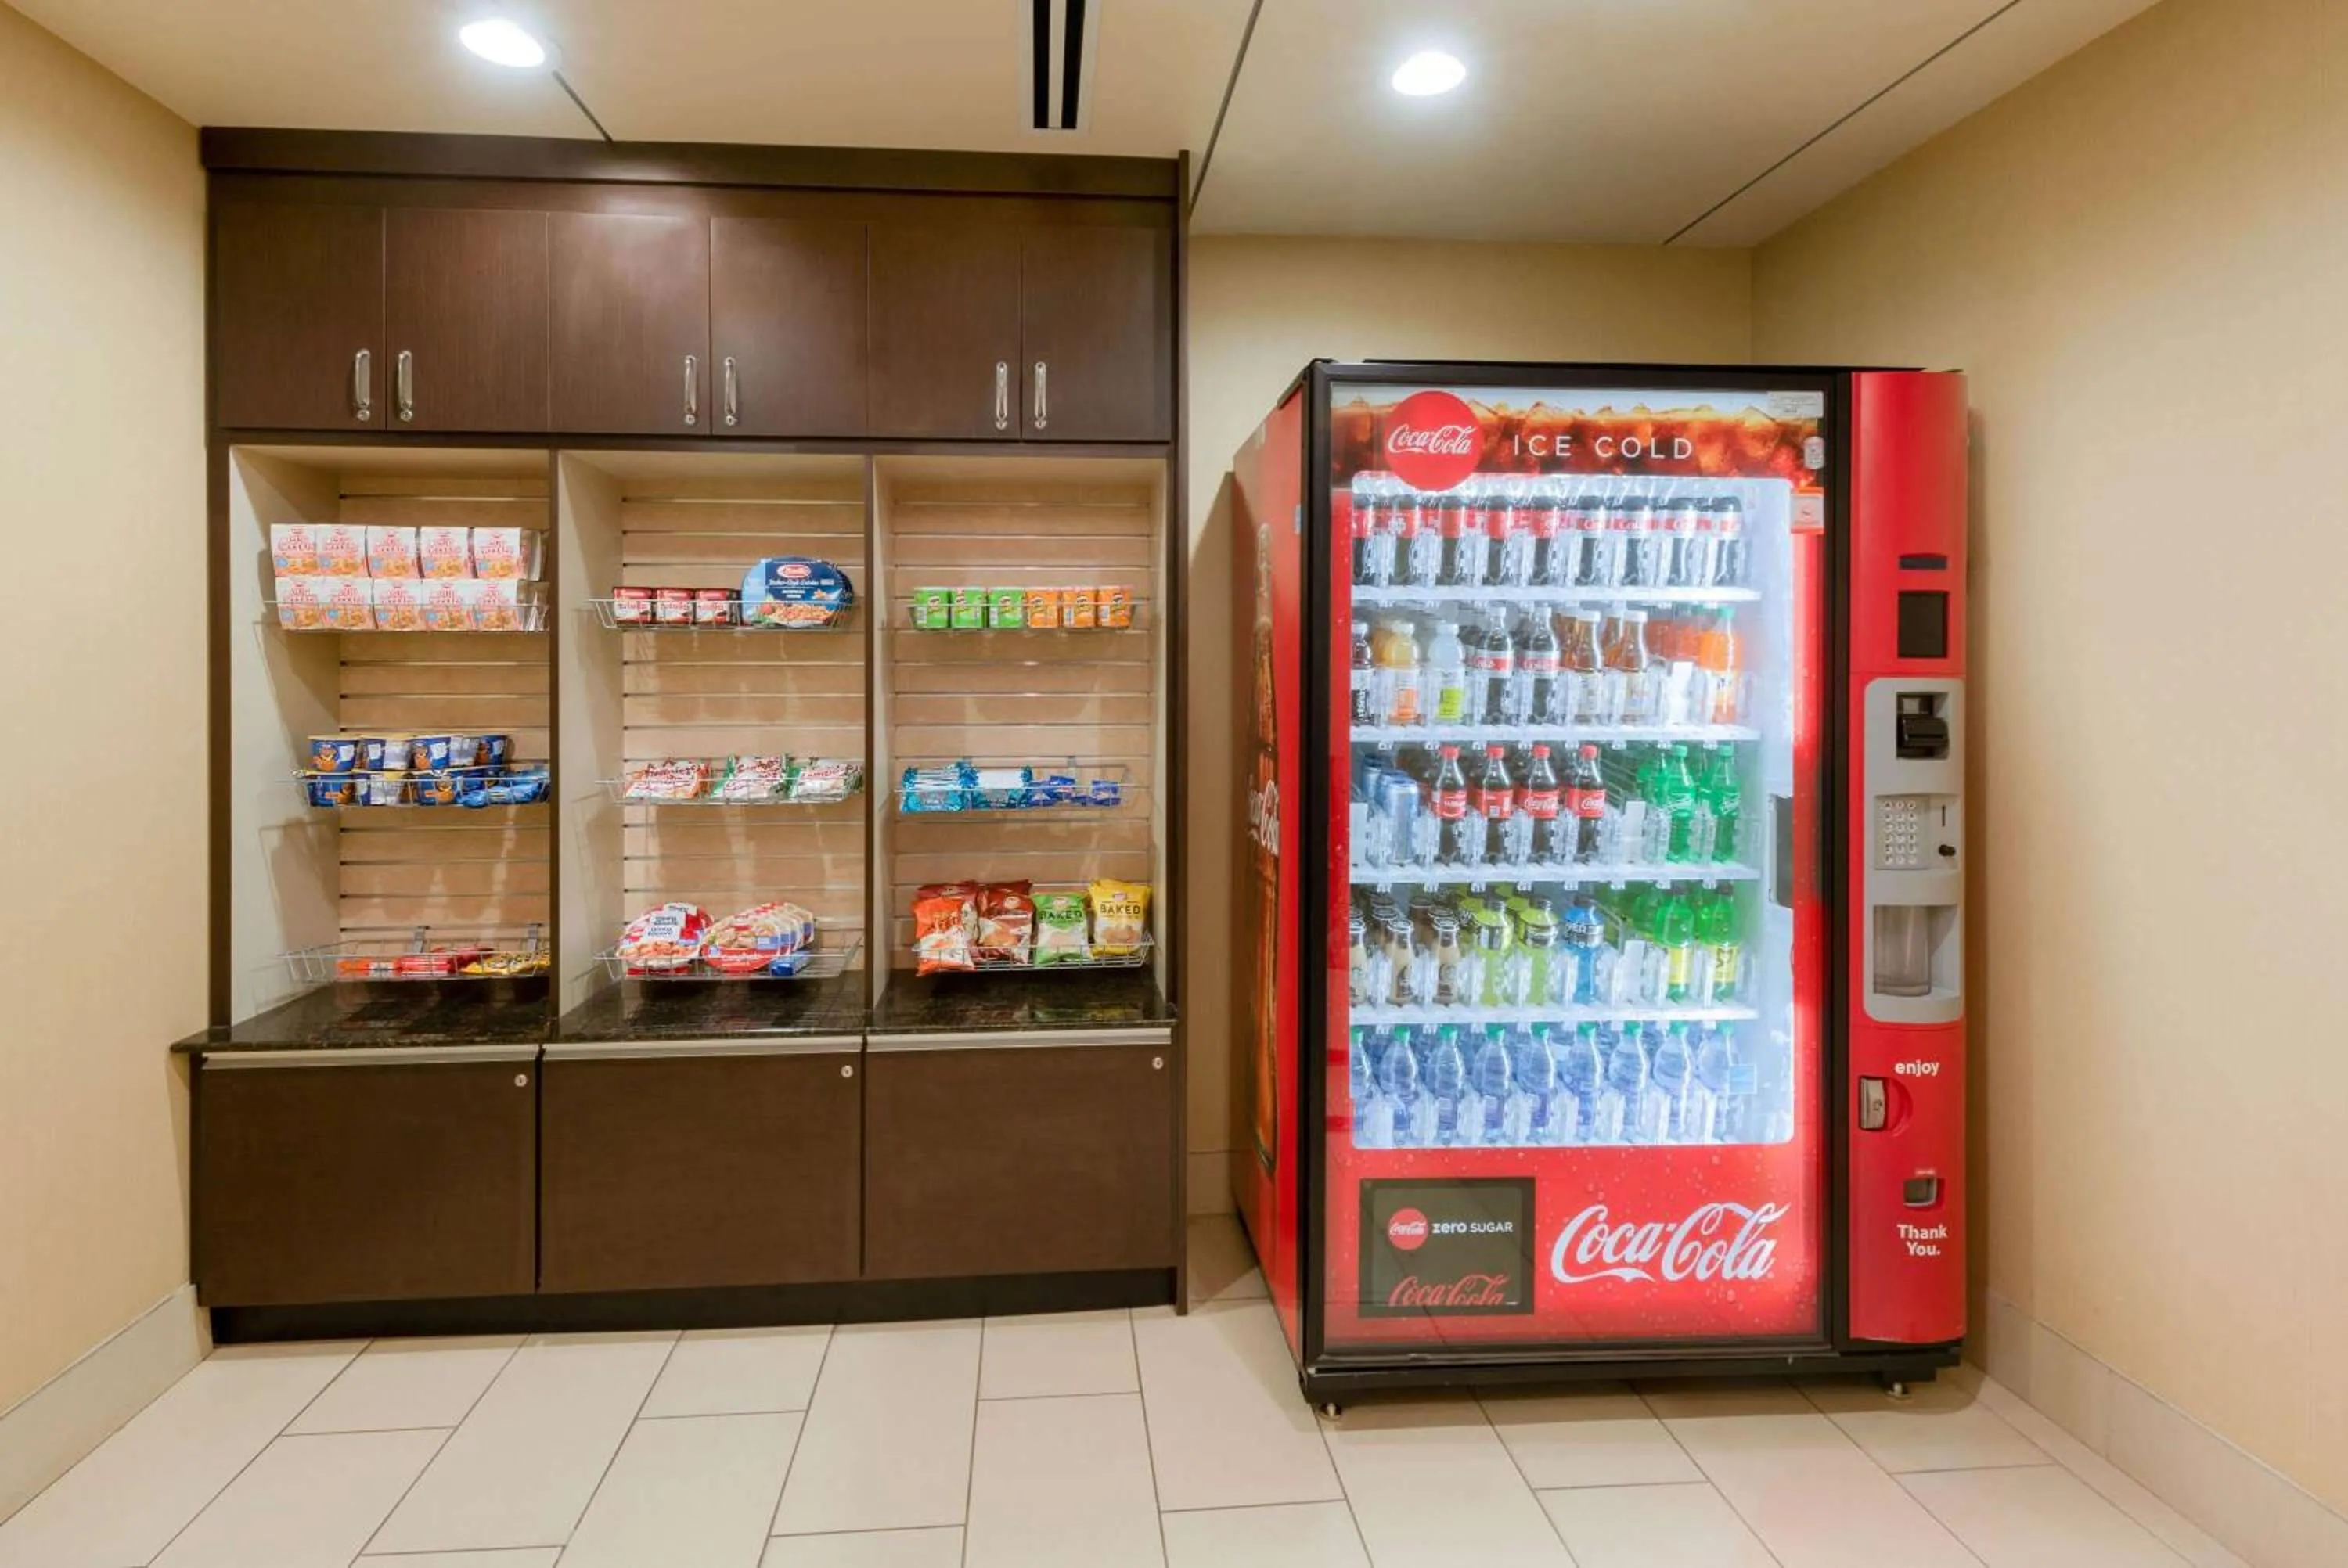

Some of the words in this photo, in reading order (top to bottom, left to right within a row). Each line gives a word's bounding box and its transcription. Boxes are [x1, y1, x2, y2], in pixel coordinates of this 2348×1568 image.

[1388, 423, 1477, 455] Coca-Cola
[1514, 435, 1572, 457] ICE
[1595, 436, 1693, 459] COLD
[1100, 904, 1140, 915] BAKED
[1894, 1059, 1940, 1077] enjoy
[1431, 1222, 1467, 1234] zero
[1470, 1221, 1514, 1232] SUGAR
[1896, 1224, 1948, 1239] Thank
[1550, 1201, 1790, 1282] Coca-Cola
[1906, 1241, 1941, 1256] You.
